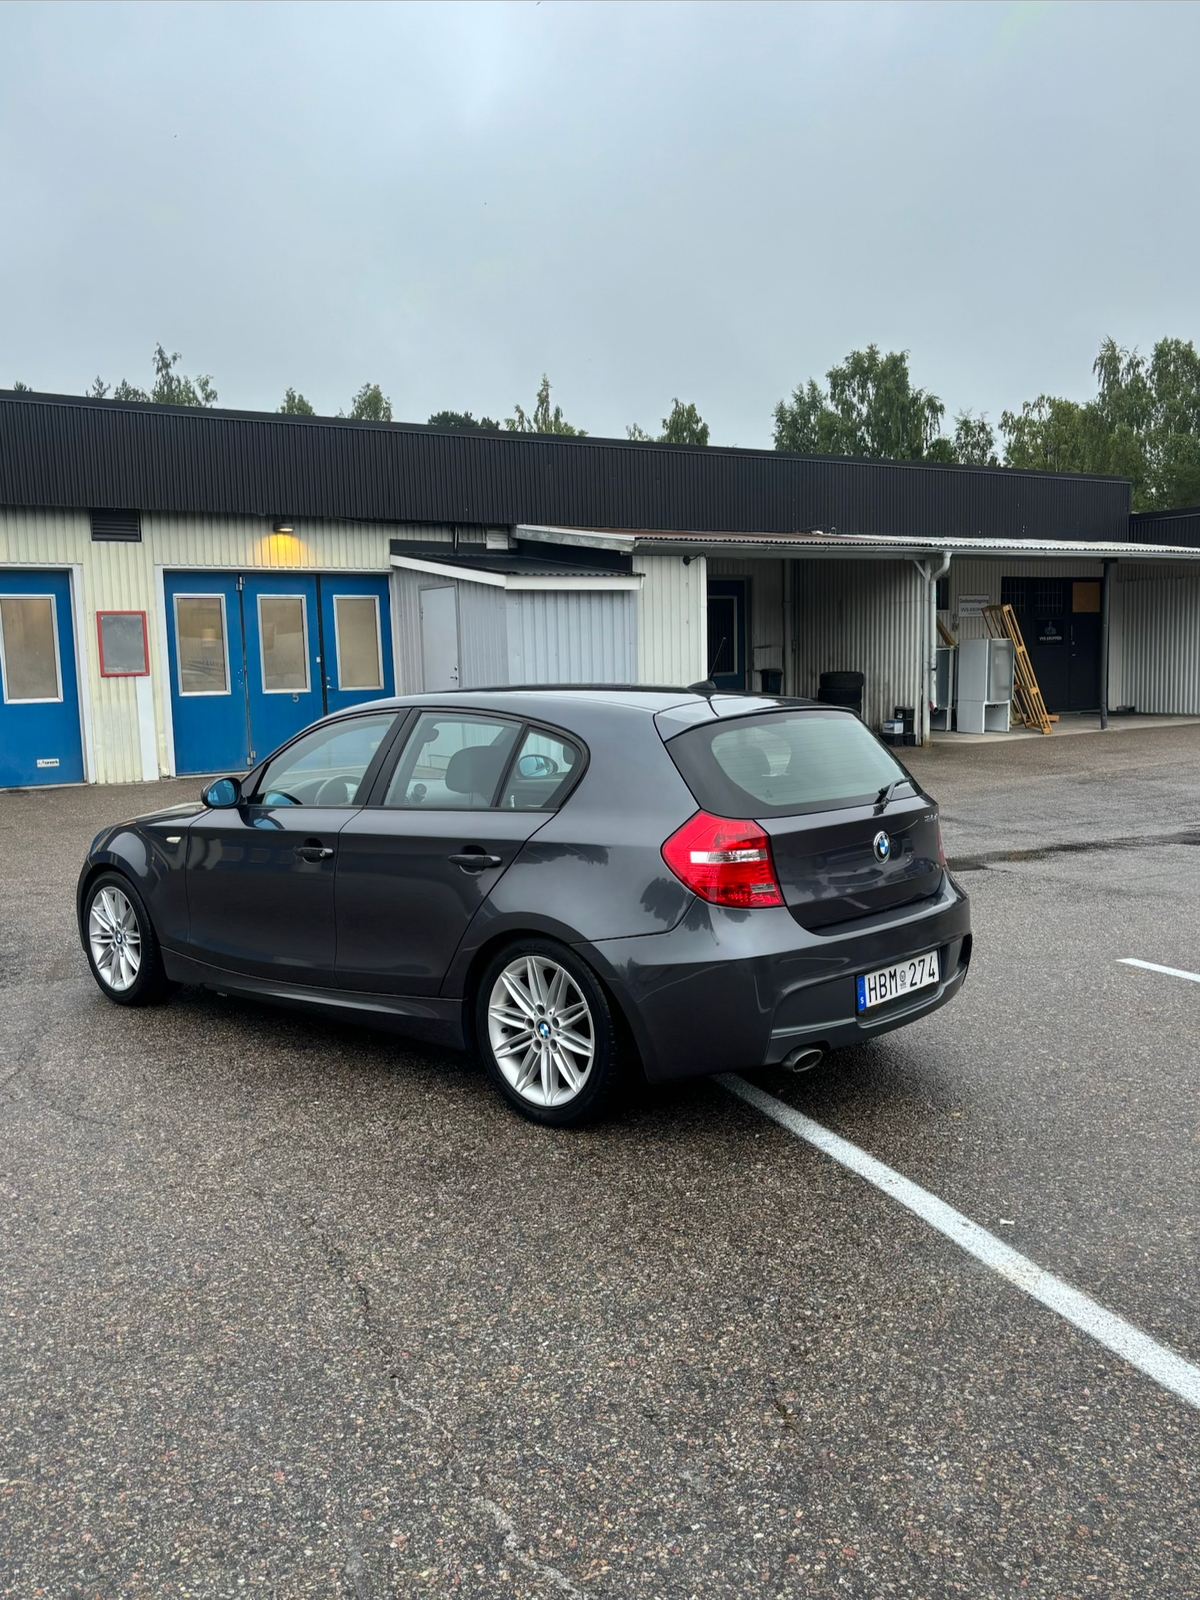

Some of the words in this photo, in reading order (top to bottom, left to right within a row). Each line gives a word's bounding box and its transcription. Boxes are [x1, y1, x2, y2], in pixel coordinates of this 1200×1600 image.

[867, 968, 899, 1004] HBM
[908, 955, 936, 988] 274
[860, 996, 864, 1005] S
